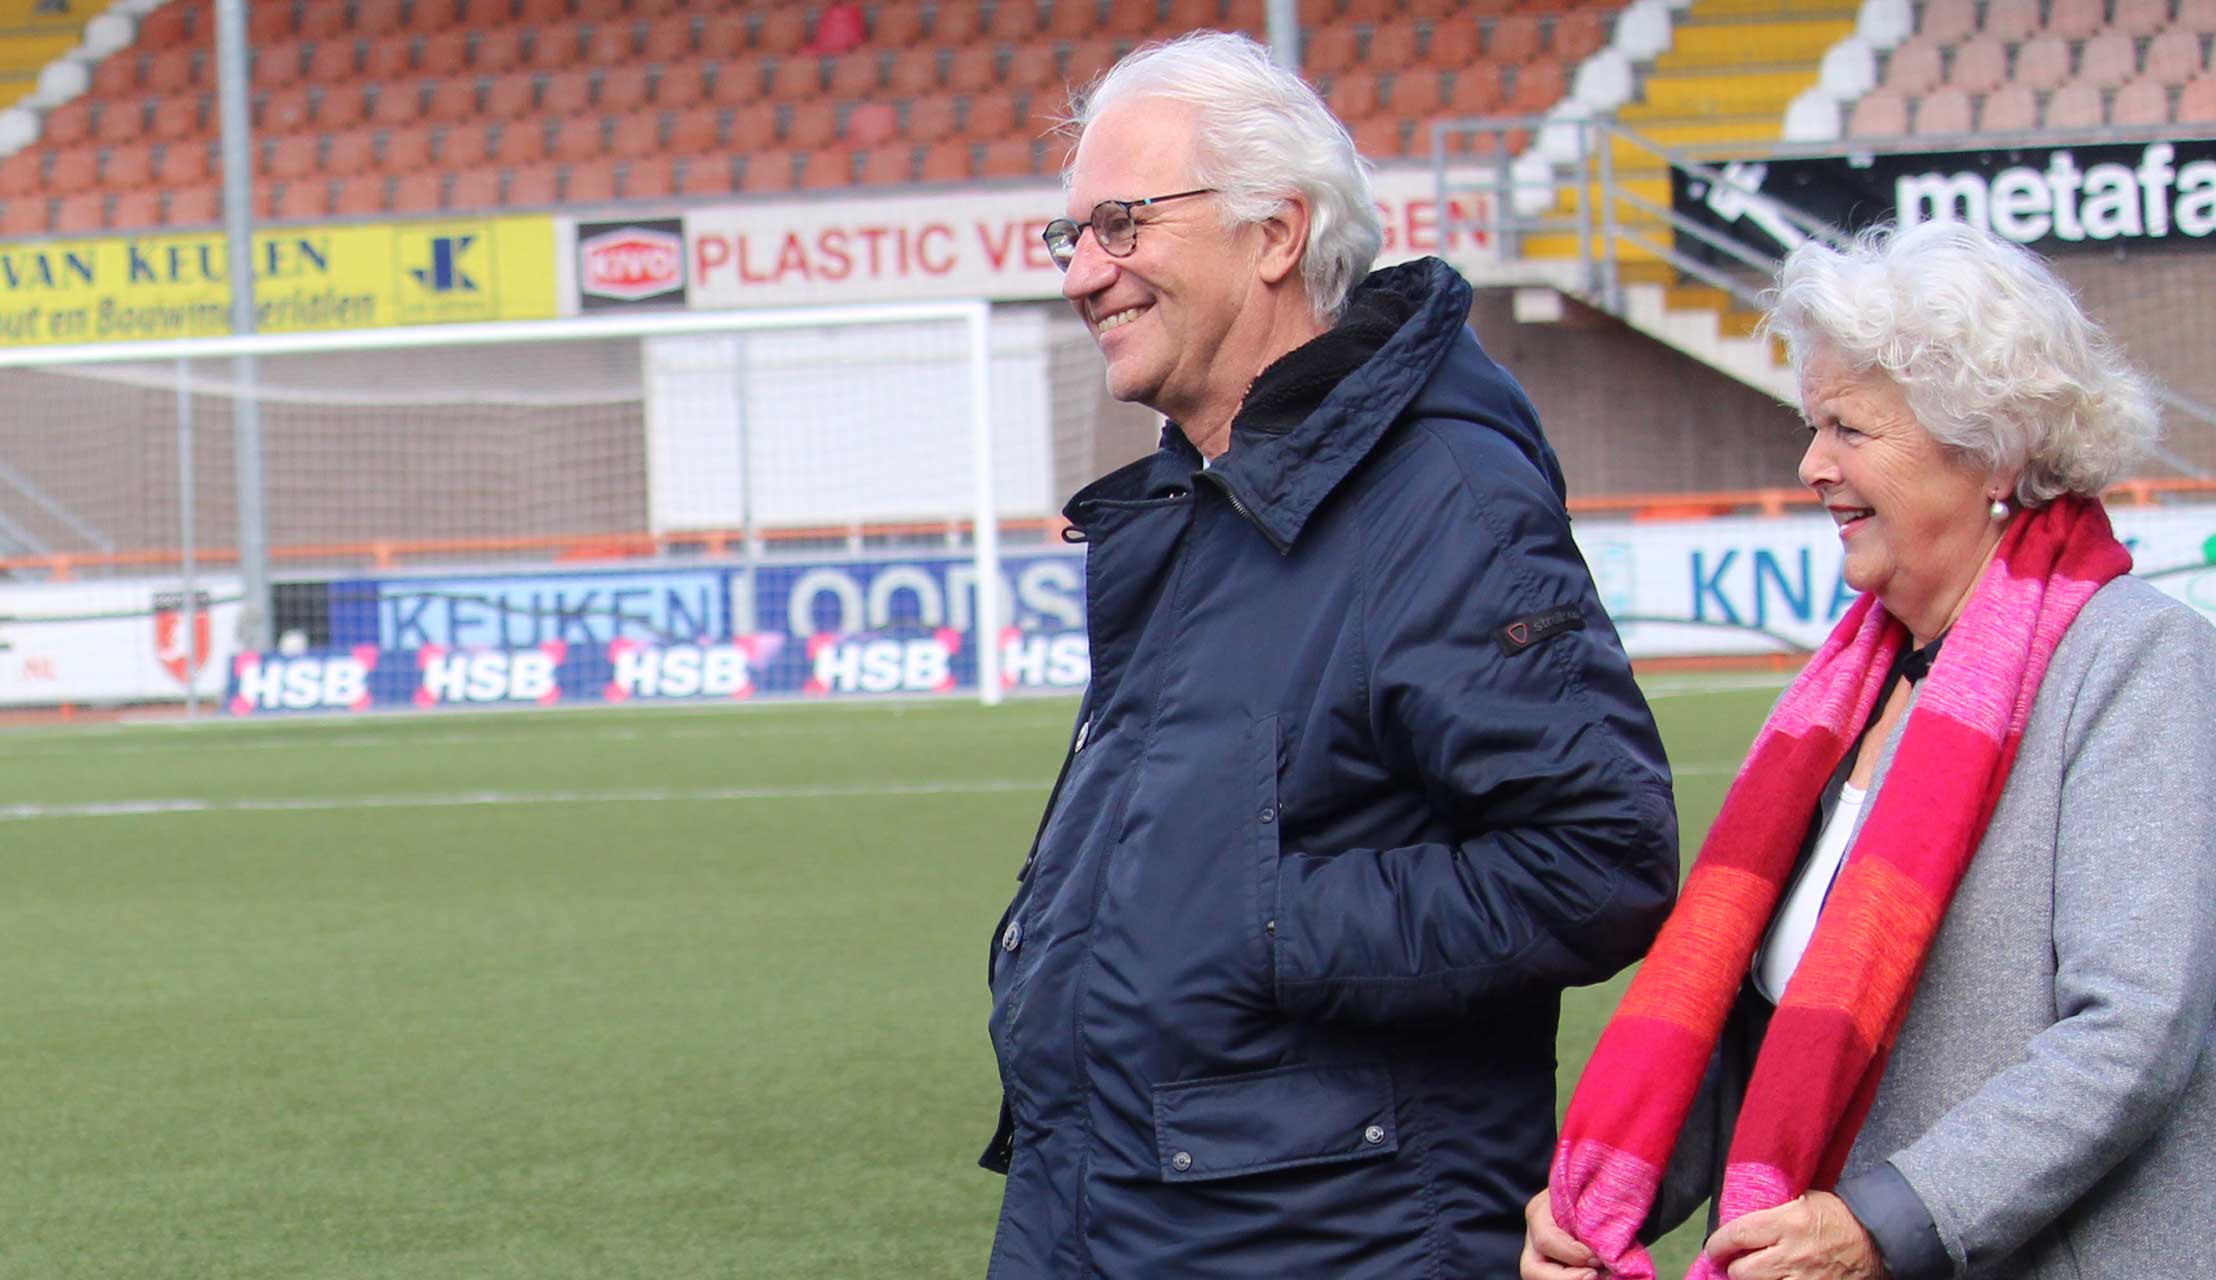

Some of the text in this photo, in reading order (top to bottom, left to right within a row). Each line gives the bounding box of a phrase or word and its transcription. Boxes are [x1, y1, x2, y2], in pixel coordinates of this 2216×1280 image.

[1, 239, 329, 287] VAN KEUEN
[695, 218, 957, 287] PLASTIC
[975, 218, 1058, 272] VE
[238, 654, 368, 708] HSB
[422, 651, 557, 701] HSB
[613, 644, 749, 696] HSB
[814, 639, 947, 692] HSB
[1004, 632, 1090, 685] HS
